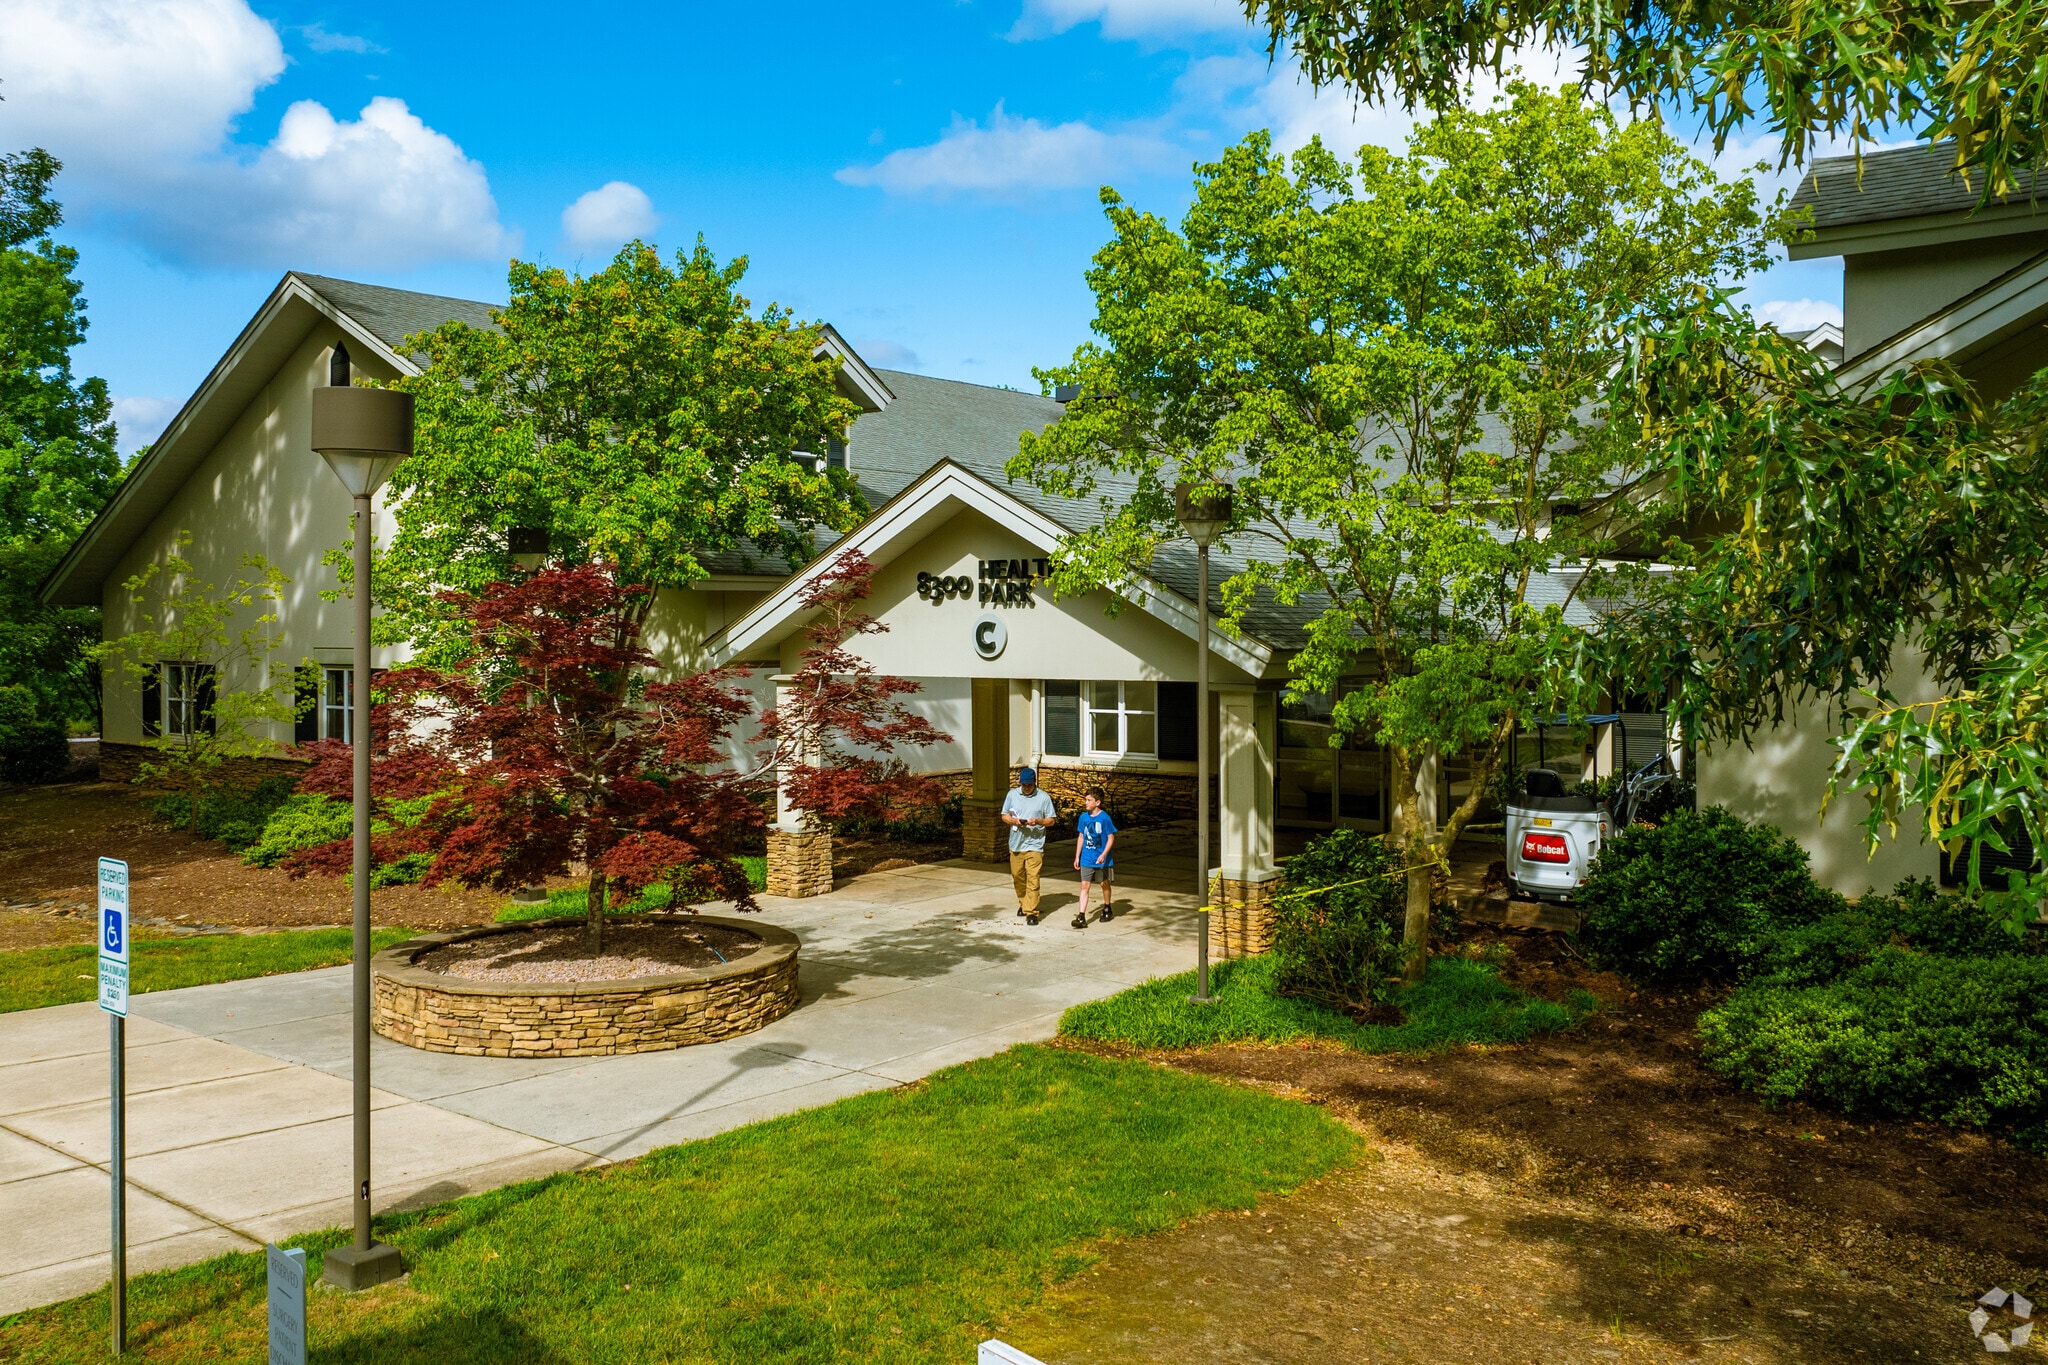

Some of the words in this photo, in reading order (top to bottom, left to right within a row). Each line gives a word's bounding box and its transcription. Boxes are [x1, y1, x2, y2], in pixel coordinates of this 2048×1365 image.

[917, 571, 971, 599] 8300
[979, 582, 1033, 602] PARK
[975, 621, 997, 653] C
[1537, 844, 1564, 855] Bobcat
[100, 867, 125, 885] RESERVED
[101, 885, 124, 903] PARKING
[100, 961, 126, 978] MAXIMUM
[100, 973, 126, 990] PENALTY
[271, 1256, 298, 1288] RESERVED
[274, 1326, 297, 1358] PATIENT
